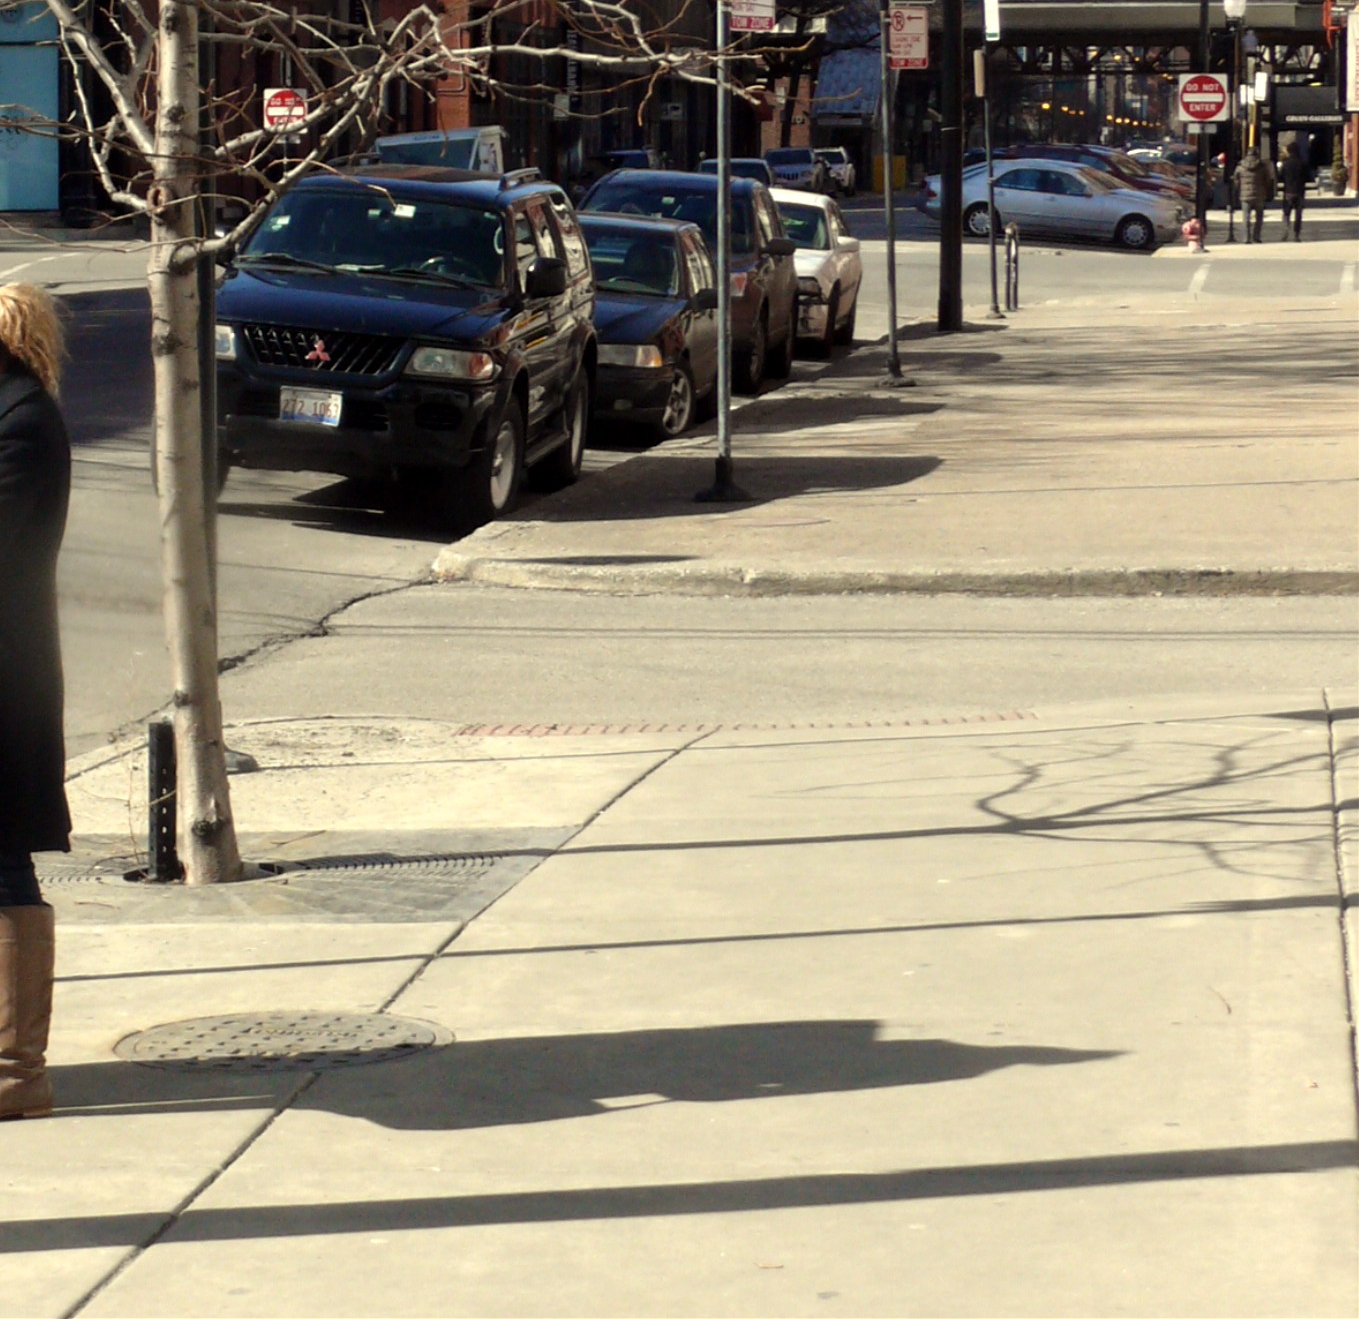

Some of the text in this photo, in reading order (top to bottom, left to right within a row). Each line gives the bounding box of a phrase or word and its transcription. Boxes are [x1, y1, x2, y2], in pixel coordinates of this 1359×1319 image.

[751, 17, 770, 30] ZONE
[1186, 83, 1220, 91] DO NOT
[1189, 103, 1217, 112] ENTER
